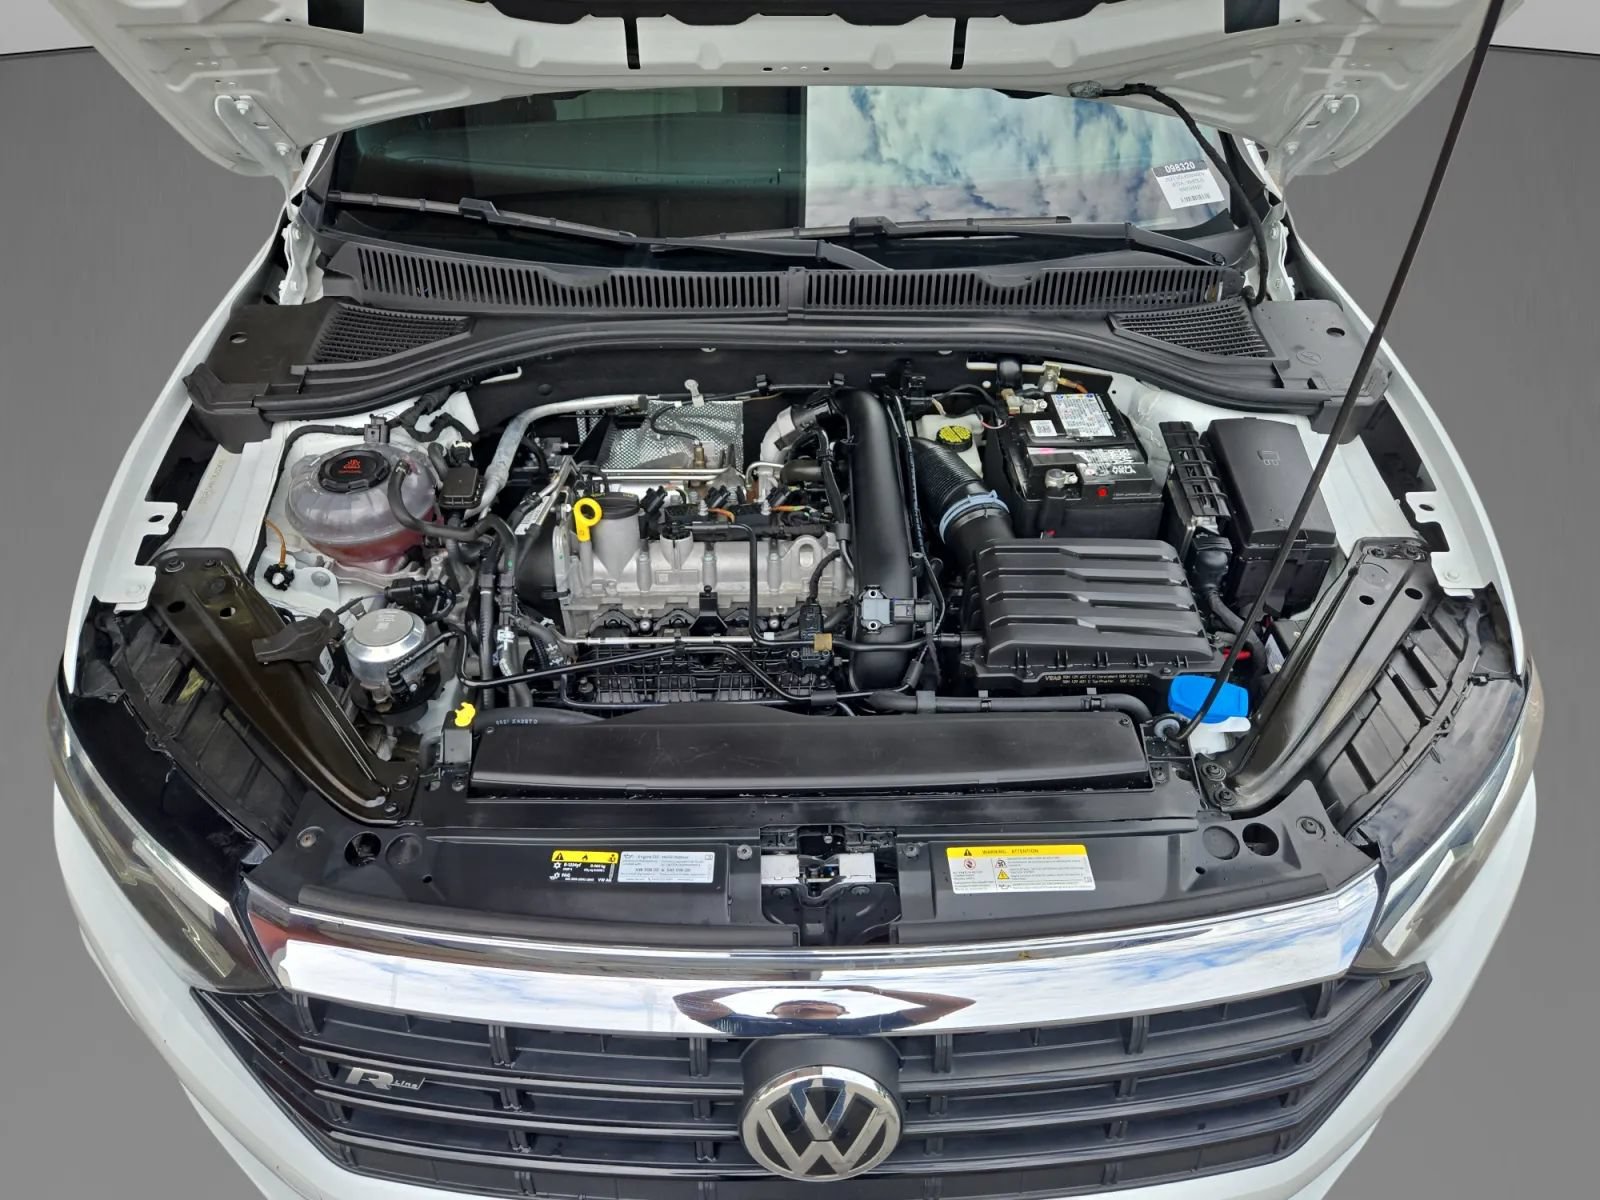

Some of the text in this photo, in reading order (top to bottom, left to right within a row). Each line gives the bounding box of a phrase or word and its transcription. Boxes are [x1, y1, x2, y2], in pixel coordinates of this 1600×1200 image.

[1164, 161, 1196, 173] 098320
[344, 1067, 394, 1090] R
[749, 1069, 894, 1178] VW
